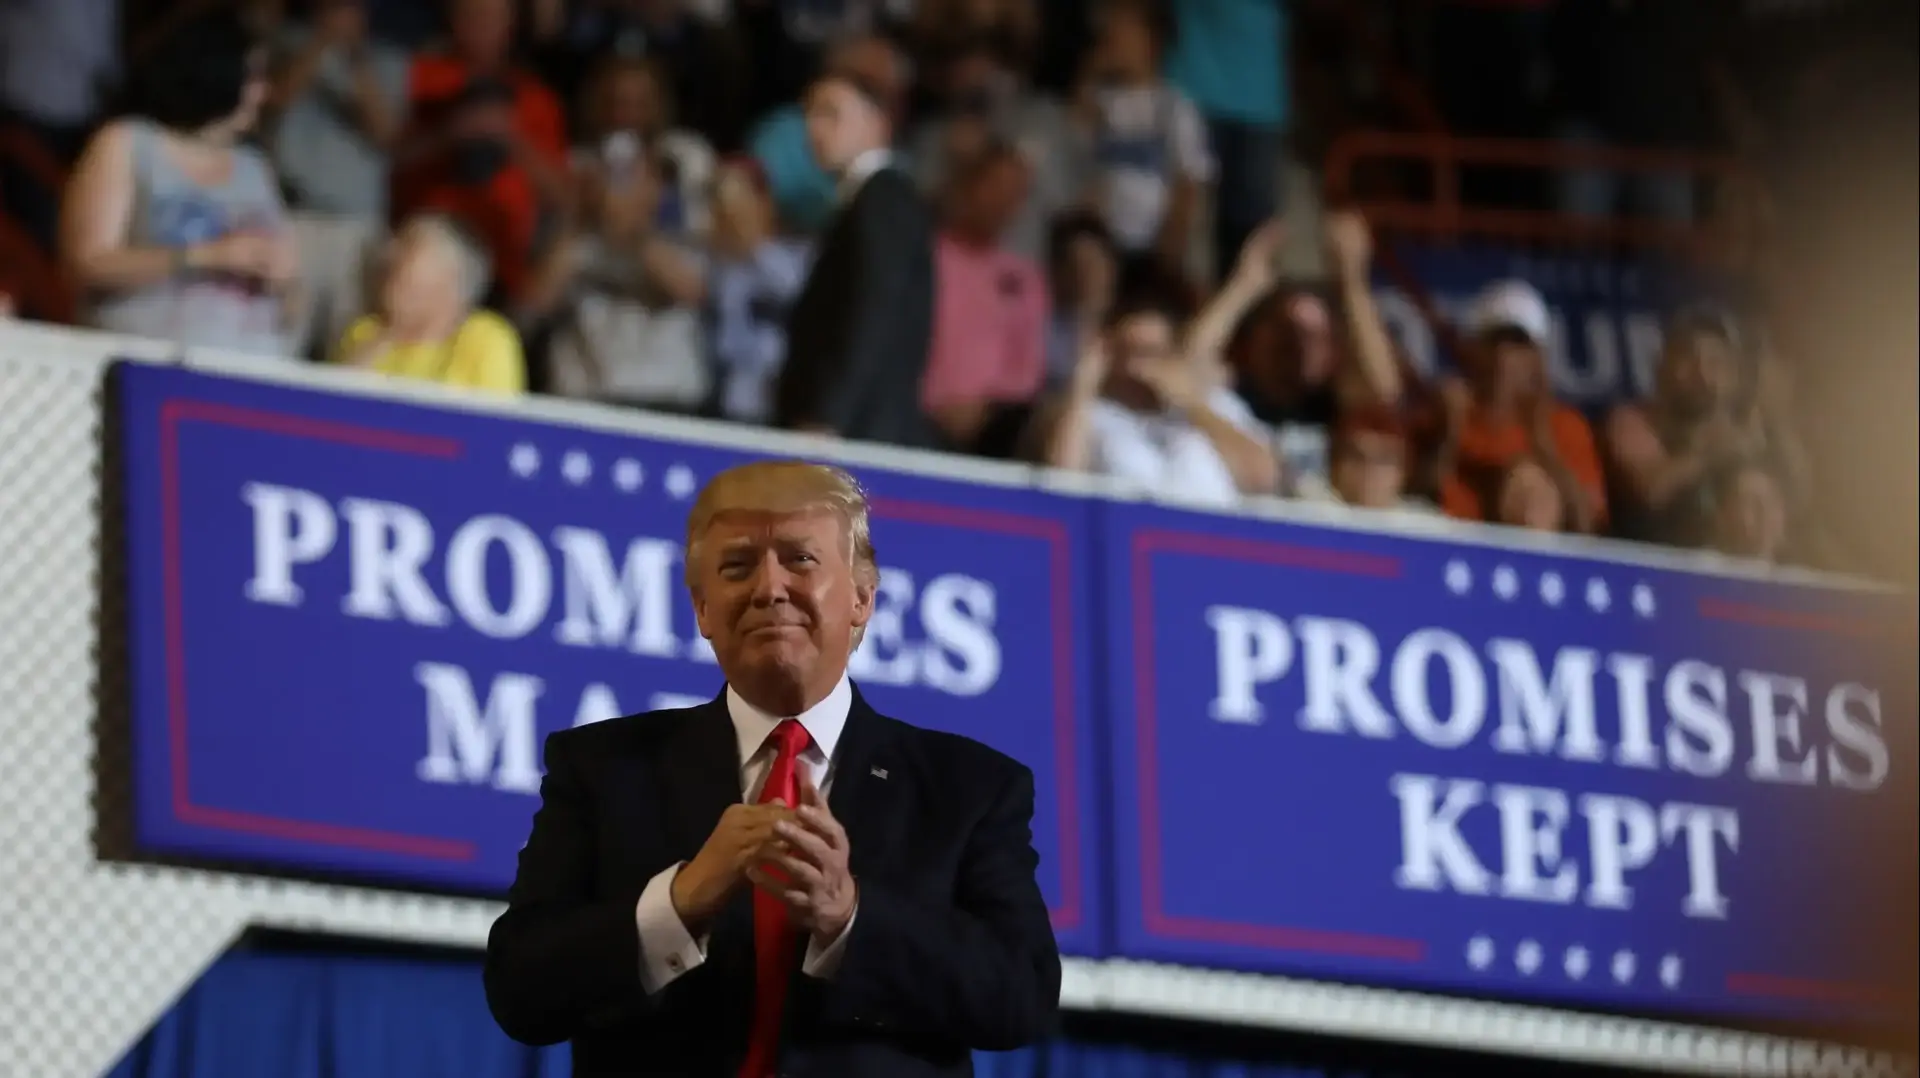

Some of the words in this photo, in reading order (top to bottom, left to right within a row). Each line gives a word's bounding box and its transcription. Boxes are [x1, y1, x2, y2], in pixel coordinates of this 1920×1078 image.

[242, 481, 1001, 695] PROMES
[1205, 604, 1890, 792] PROMISES
[1389, 772, 1739, 919] KEPT
